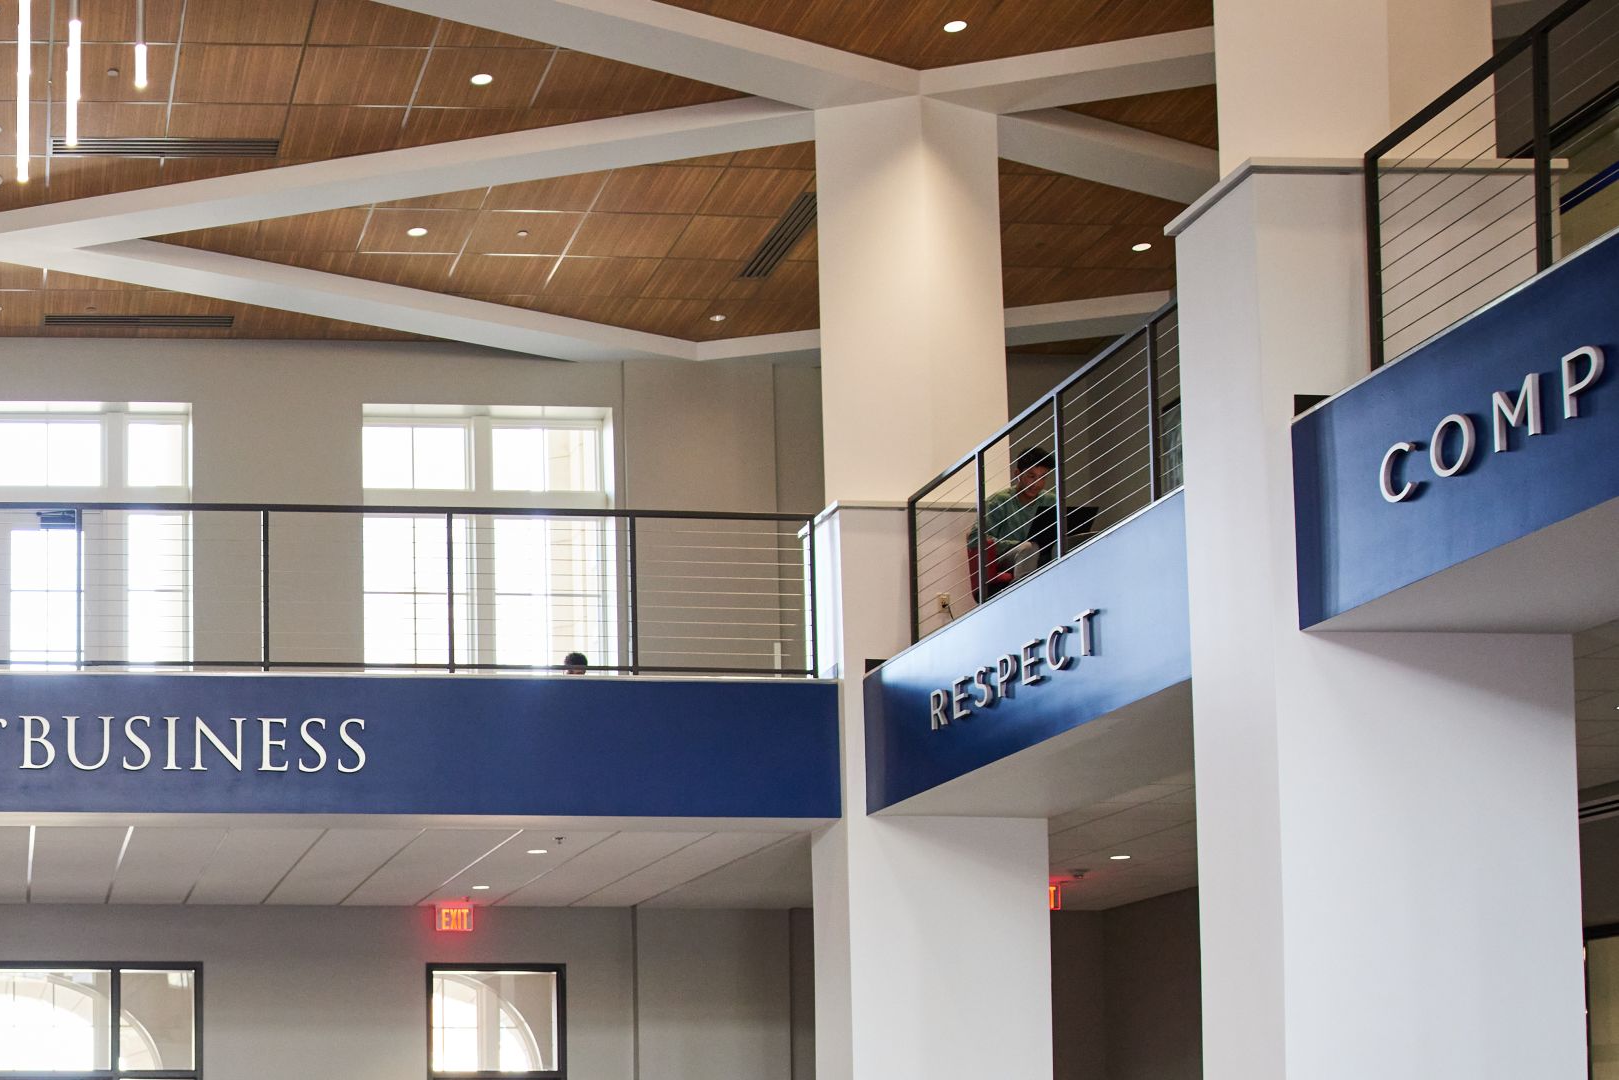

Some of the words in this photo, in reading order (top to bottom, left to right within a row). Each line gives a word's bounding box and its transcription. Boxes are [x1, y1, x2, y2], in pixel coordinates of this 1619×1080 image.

[1379, 345, 1605, 503] COMP
[930, 608, 1100, 731] RESPECT
[19, 715, 368, 774] BUSINESS
[441, 908, 469, 930] EXIT
